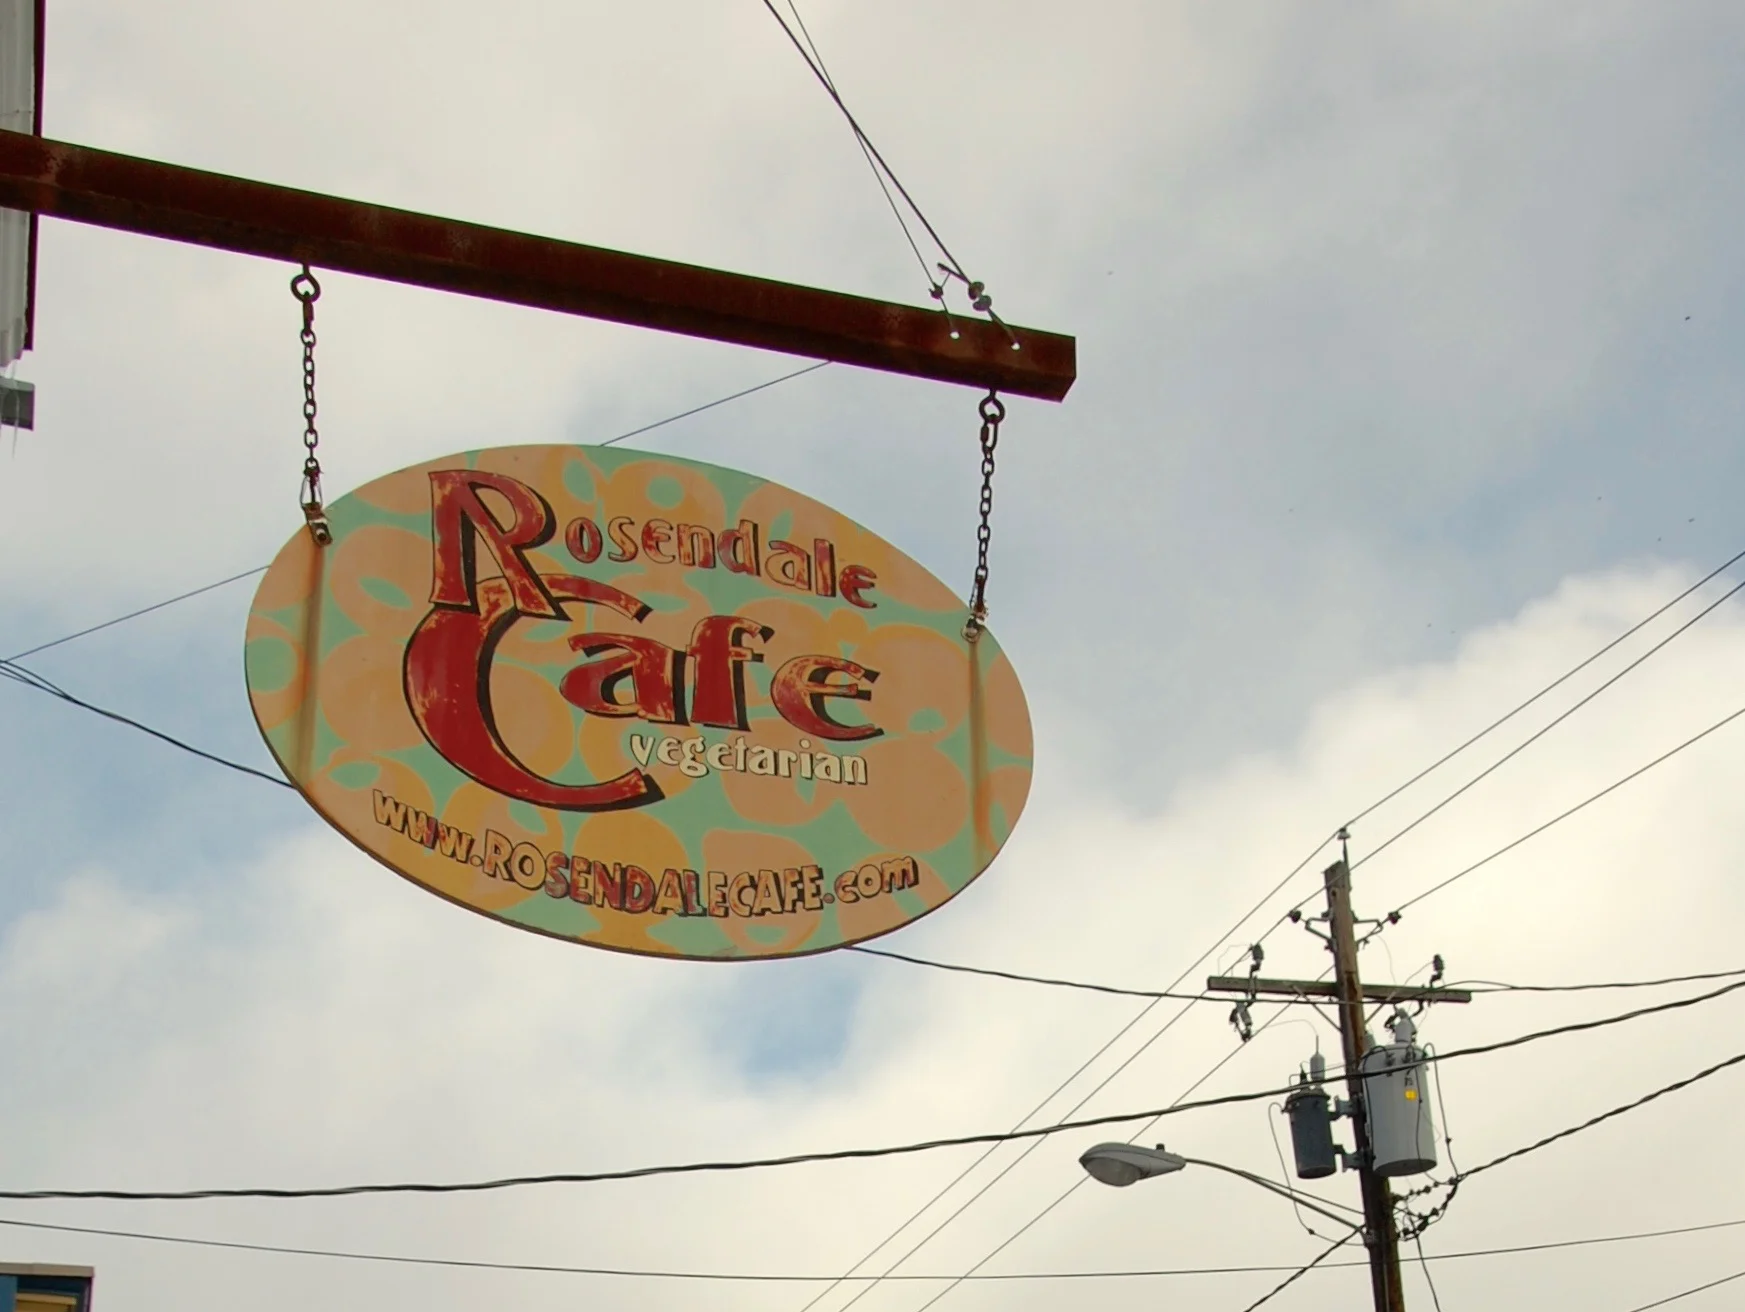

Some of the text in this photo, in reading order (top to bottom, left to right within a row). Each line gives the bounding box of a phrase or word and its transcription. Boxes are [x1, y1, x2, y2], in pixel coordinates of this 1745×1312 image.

[428, 470, 878, 619] Rosendale
[402, 573, 885, 812] Cafe
[629, 730, 869, 786] vegetarian
